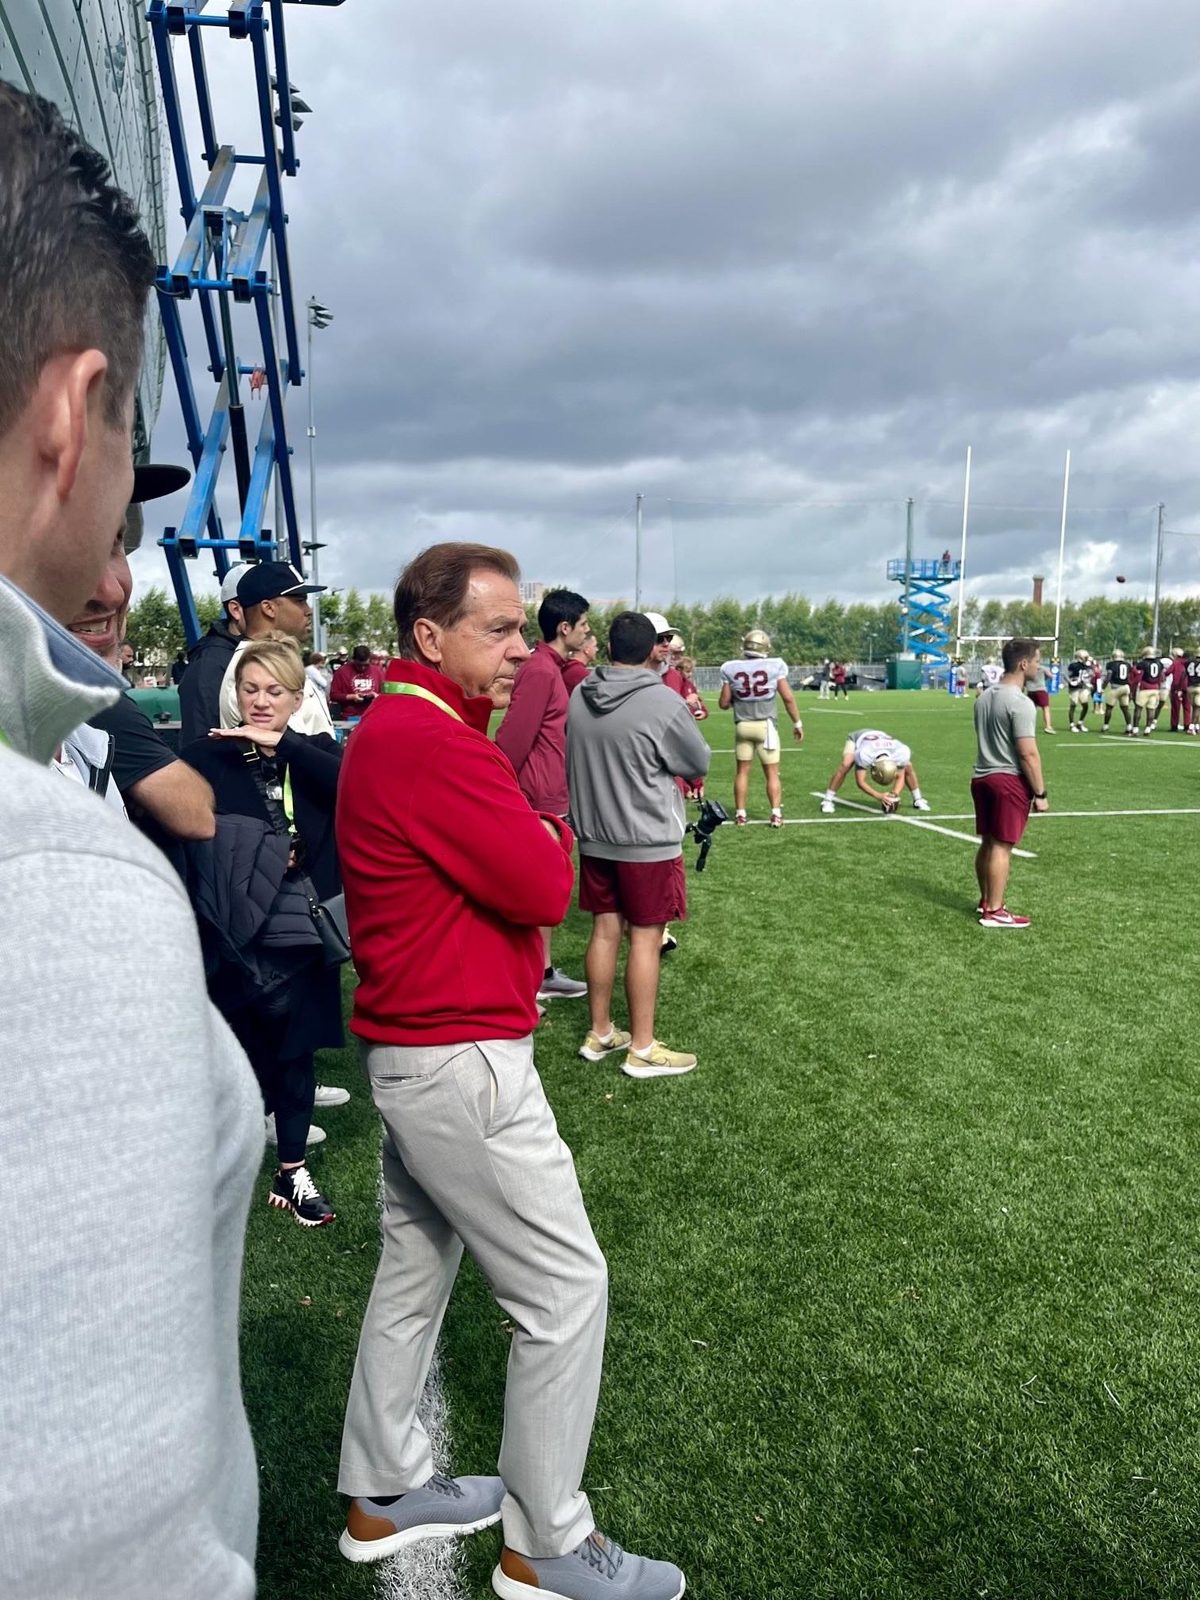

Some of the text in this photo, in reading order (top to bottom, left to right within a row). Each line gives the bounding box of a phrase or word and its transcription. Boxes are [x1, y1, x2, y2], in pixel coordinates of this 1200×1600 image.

[1119, 663, 1128, 680] 0
[1150, 662, 1159, 678] 0
[733, 670, 770, 698] 32
